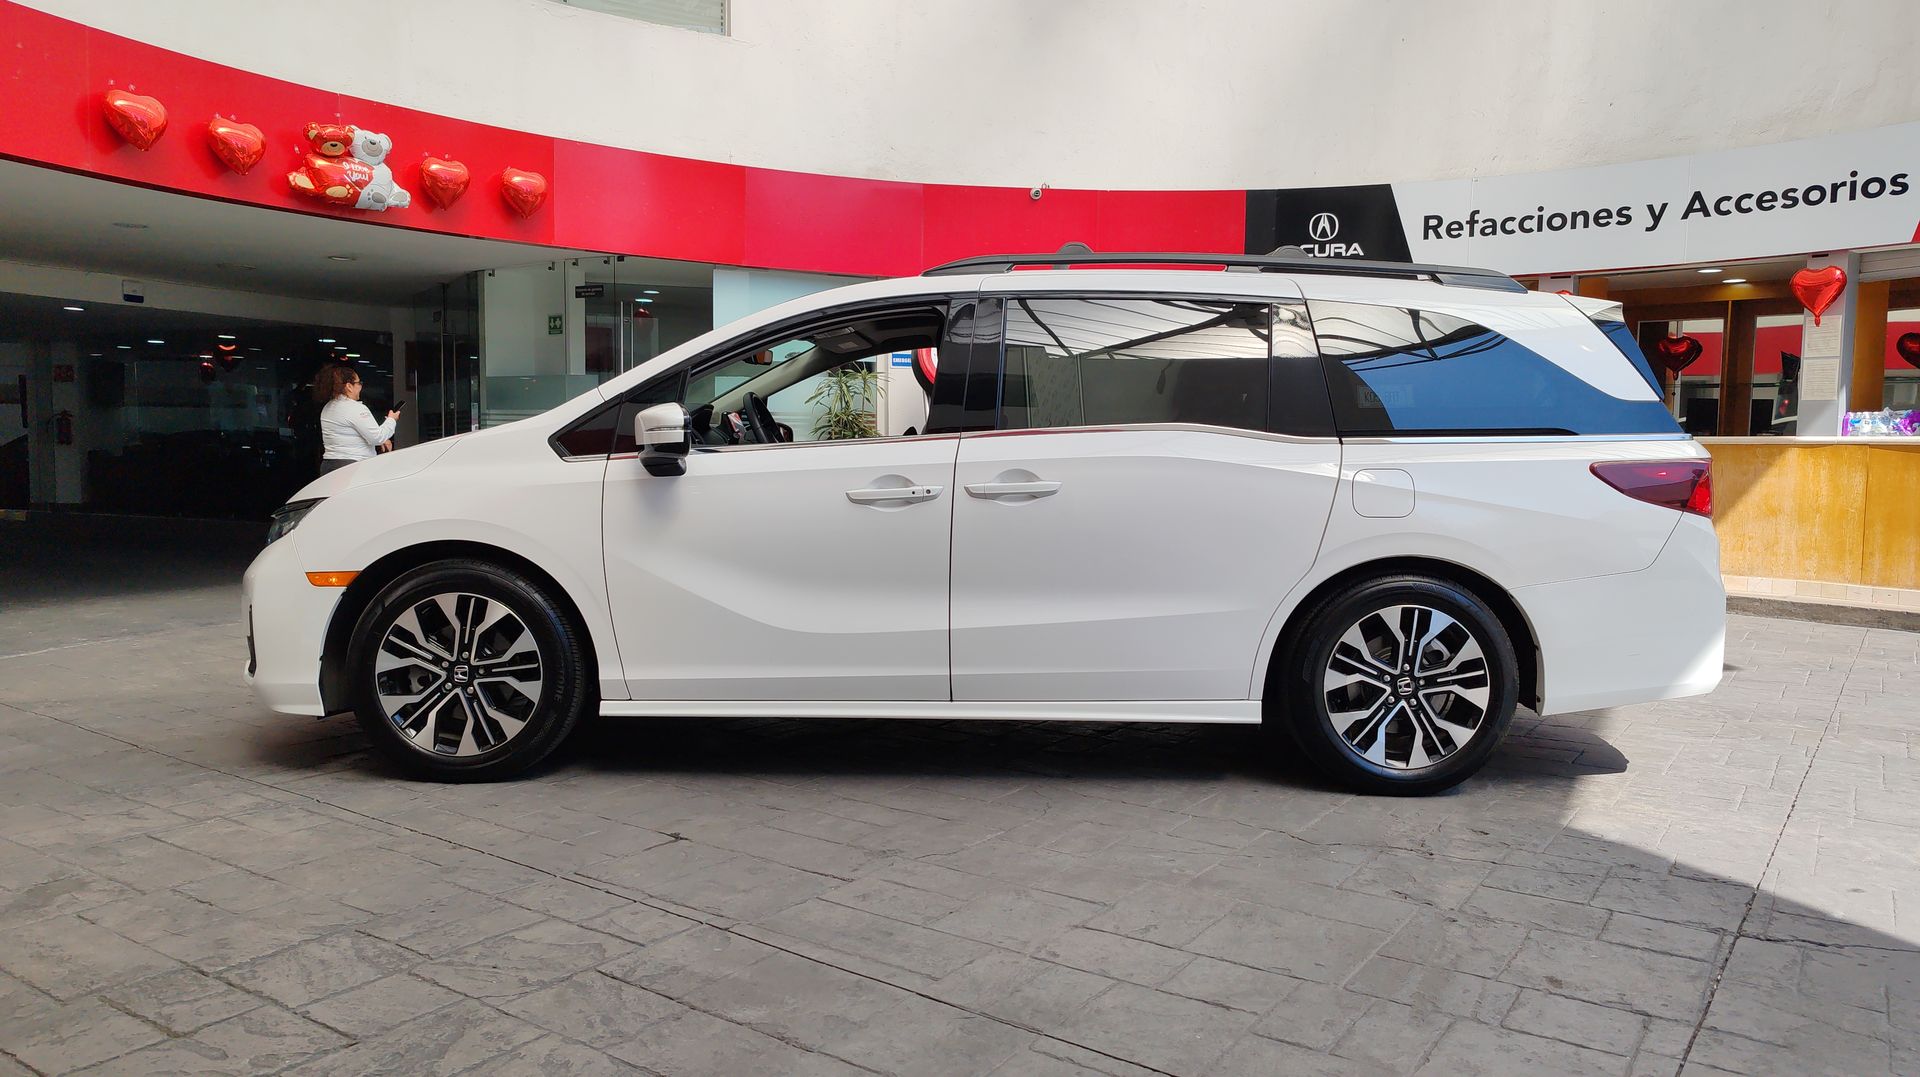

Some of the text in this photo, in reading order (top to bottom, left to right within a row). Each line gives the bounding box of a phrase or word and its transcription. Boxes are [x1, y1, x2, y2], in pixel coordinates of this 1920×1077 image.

[1422, 170, 1909, 240] Refacciones y Accesorios
[1300, 243, 1364, 258] CURA
